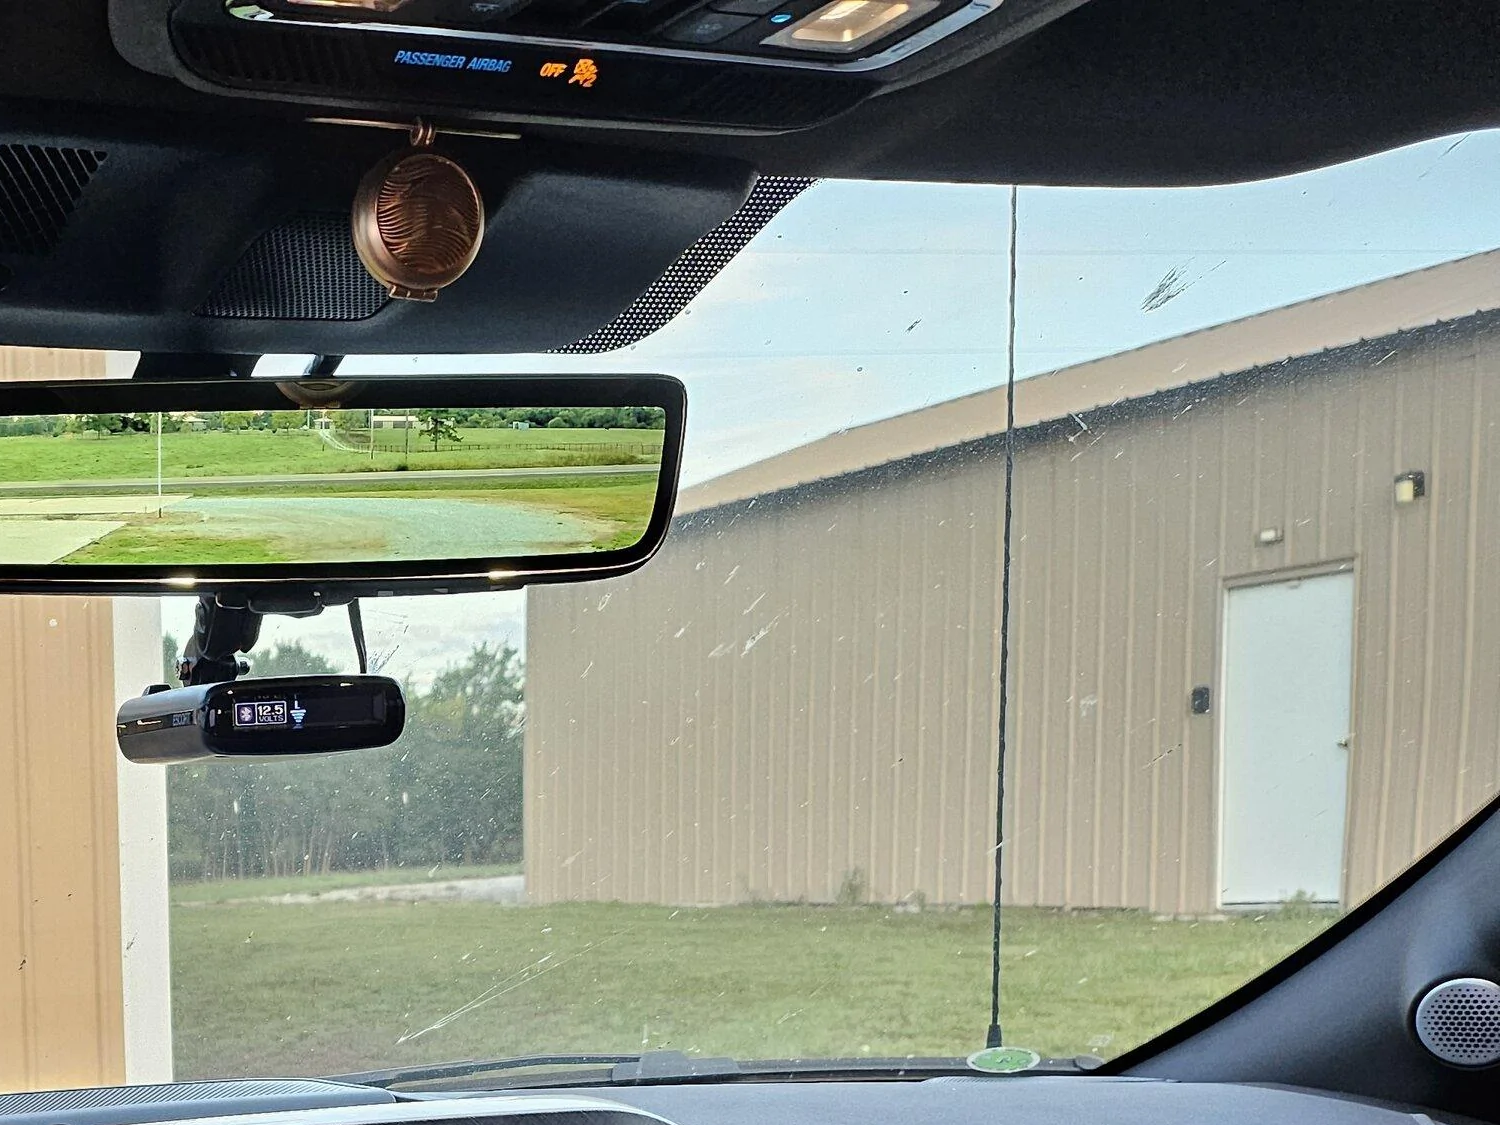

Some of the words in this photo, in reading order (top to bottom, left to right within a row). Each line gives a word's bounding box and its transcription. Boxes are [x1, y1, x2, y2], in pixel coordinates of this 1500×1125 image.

[394, 50, 466, 69] PASSENGER
[466, 56, 512, 73] AIRBAG
[539, 63, 568, 77] OFF
[257, 704, 284, 716] 12.5
